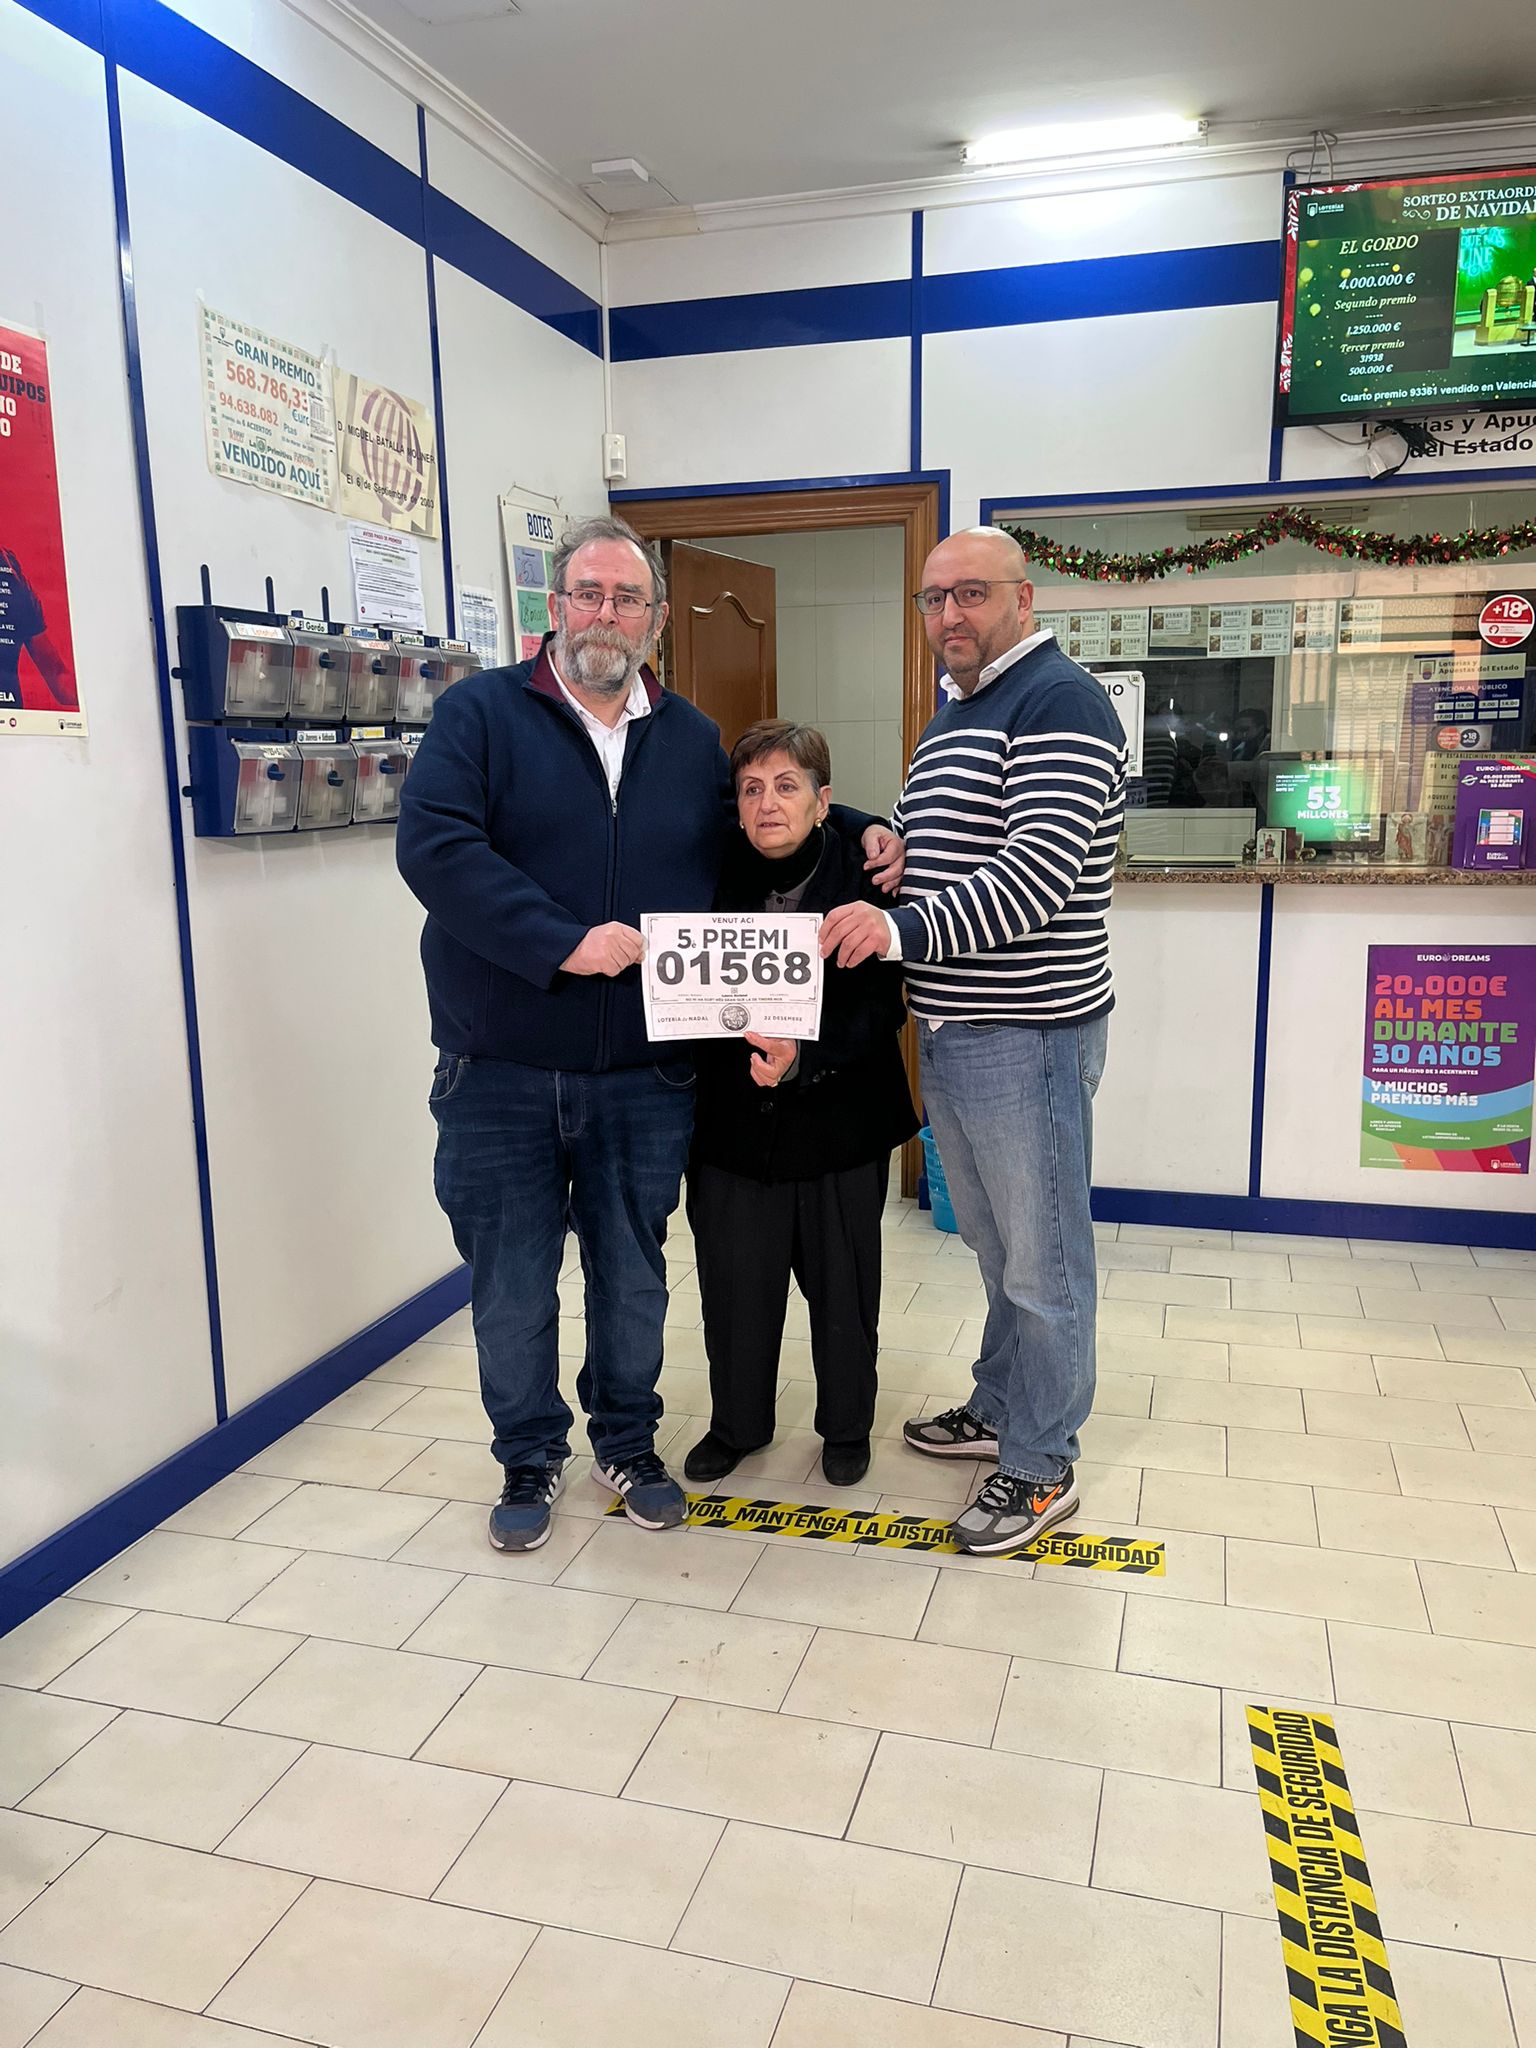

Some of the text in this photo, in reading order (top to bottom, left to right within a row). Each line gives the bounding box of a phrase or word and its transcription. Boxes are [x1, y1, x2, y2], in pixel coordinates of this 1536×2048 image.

[1403, 193, 1457, 207] SORTEO
[1436, 206, 1461, 221] DE
[1339, 235, 1419, 254] EL GORDO
[1339, 272, 1415, 290] 4.000.000 €
[1334, 293, 1417, 312] Segundo premio
[1347, 322, 1401, 336] 1.250.000 €
[1340, 340, 1405, 352] Tercer premio
[0, 351, 22, 375] DE
[235, 339, 316, 388] GRAN PREMIO
[1360, 353, 1384, 363] 31938
[1348, 364, 1393, 376] 500.000 €
[1340, 393, 1372, 402] Cuarto
[1374, 389, 1408, 402] premio
[1440, 384, 1478, 394] vendido
[1481, 384, 1493, 392] en
[219, 391, 279, 427] 94.638.082
[1462, 418, 1475, 434] y
[338, 420, 345, 433] D.
[348, 424, 374, 443] MIGUEL
[376, 435, 405, 456] BATALLA
[1454, 434, 1533, 455] Estado
[223, 441, 286, 478] VENDIDO
[290, 467, 322, 490] AQUÍ
[346, 473, 354, 485] El
[364, 479, 371, 490] de
[374, 482, 407, 502] Septiembre
[527, 513, 554, 540] BOTES
[1492, 601, 1523, 618] +18
[306, 622, 325, 632] Gordo
[1479, 683, 1508, 691] PÚBLICO
[1306, 786, 1342, 810] 53
[1297, 810, 1349, 819] MILLONES
[703, 929, 788, 949] PREMI
[656, 951, 812, 985] 01568
[1417, 954, 1491, 962] EURO DREAMS
[1375, 975, 1508, 997] 20.000€
[1374, 998, 1483, 1020] AL MES
[1373, 1020, 1518, 1044] DURANTE
[1372, 1040, 1502, 1067] 30 AÑOS
[1371, 1081, 1448, 1093] Y MUCHOS
[1371, 1092, 1479, 1106] PREMIOS MÁS
[734, 1507, 848, 1533] MANTENGA
[854, 1520, 879, 1537] LA
[1036, 1539, 1160, 1566] SEGURIDAD
[1272, 1711, 1327, 1812] SEGURIDAD
[1290, 1813, 1332, 1843] DE
[1297, 1845, 1358, 1962] DISTANCIA
[1316, 1965, 1367, 2000] LA
